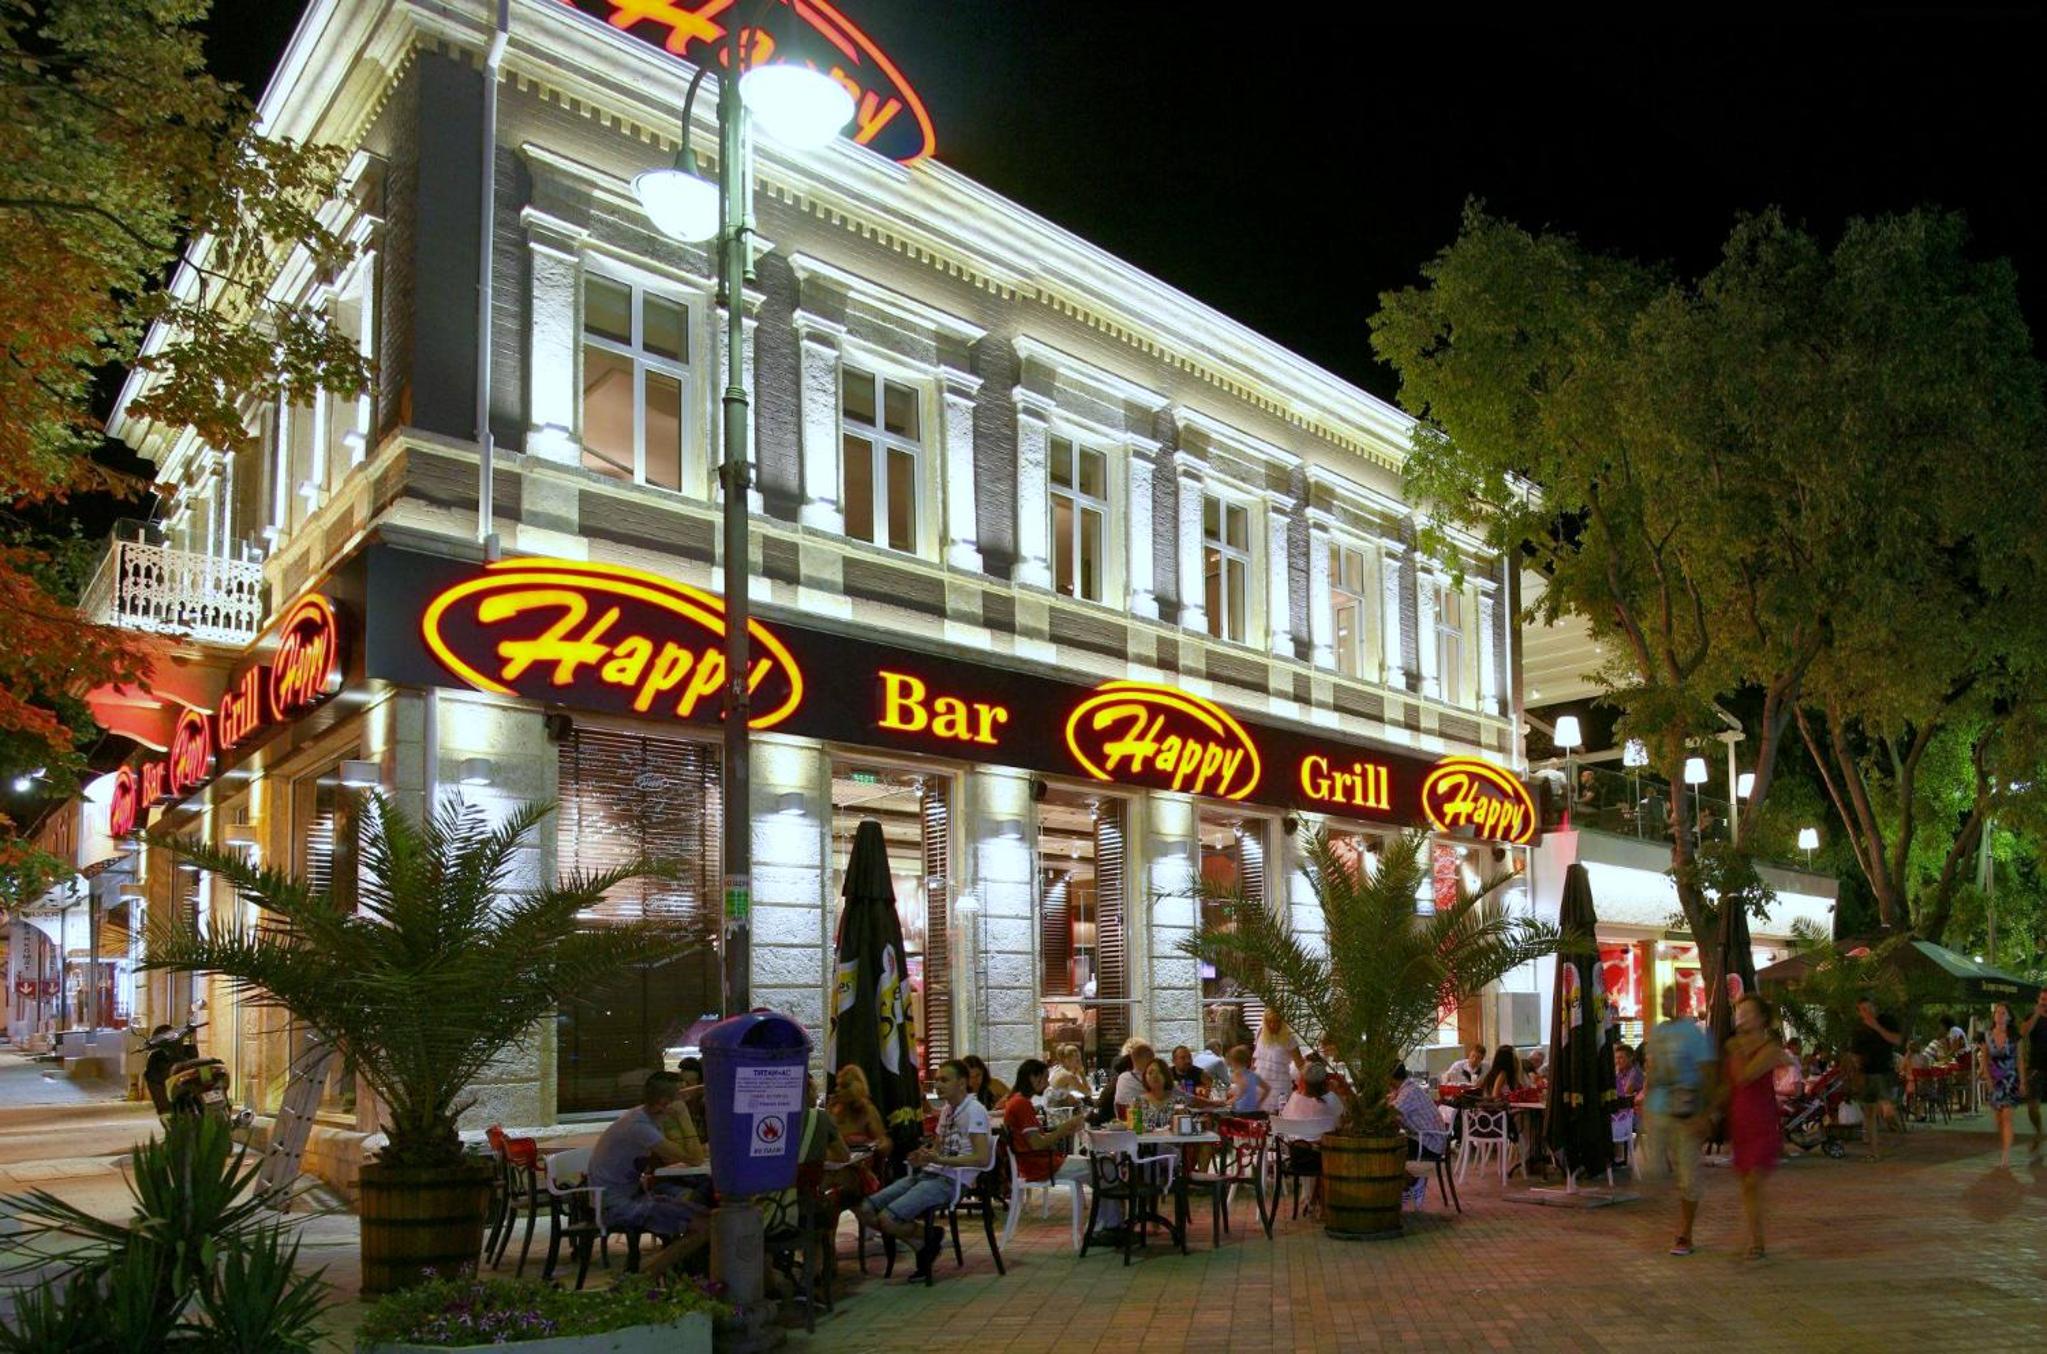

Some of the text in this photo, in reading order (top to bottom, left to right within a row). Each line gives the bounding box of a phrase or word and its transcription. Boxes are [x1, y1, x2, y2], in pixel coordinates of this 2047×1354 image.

[142, 762, 166, 808] Bar
[219, 664, 260, 750] Grill
[276, 626, 330, 710] Happy
[877, 671, 1009, 745] Bar
[1093, 704, 1244, 796] Happy
[1300, 754, 1391, 811] Grill
[1436, 773, 1526, 841] Happy
